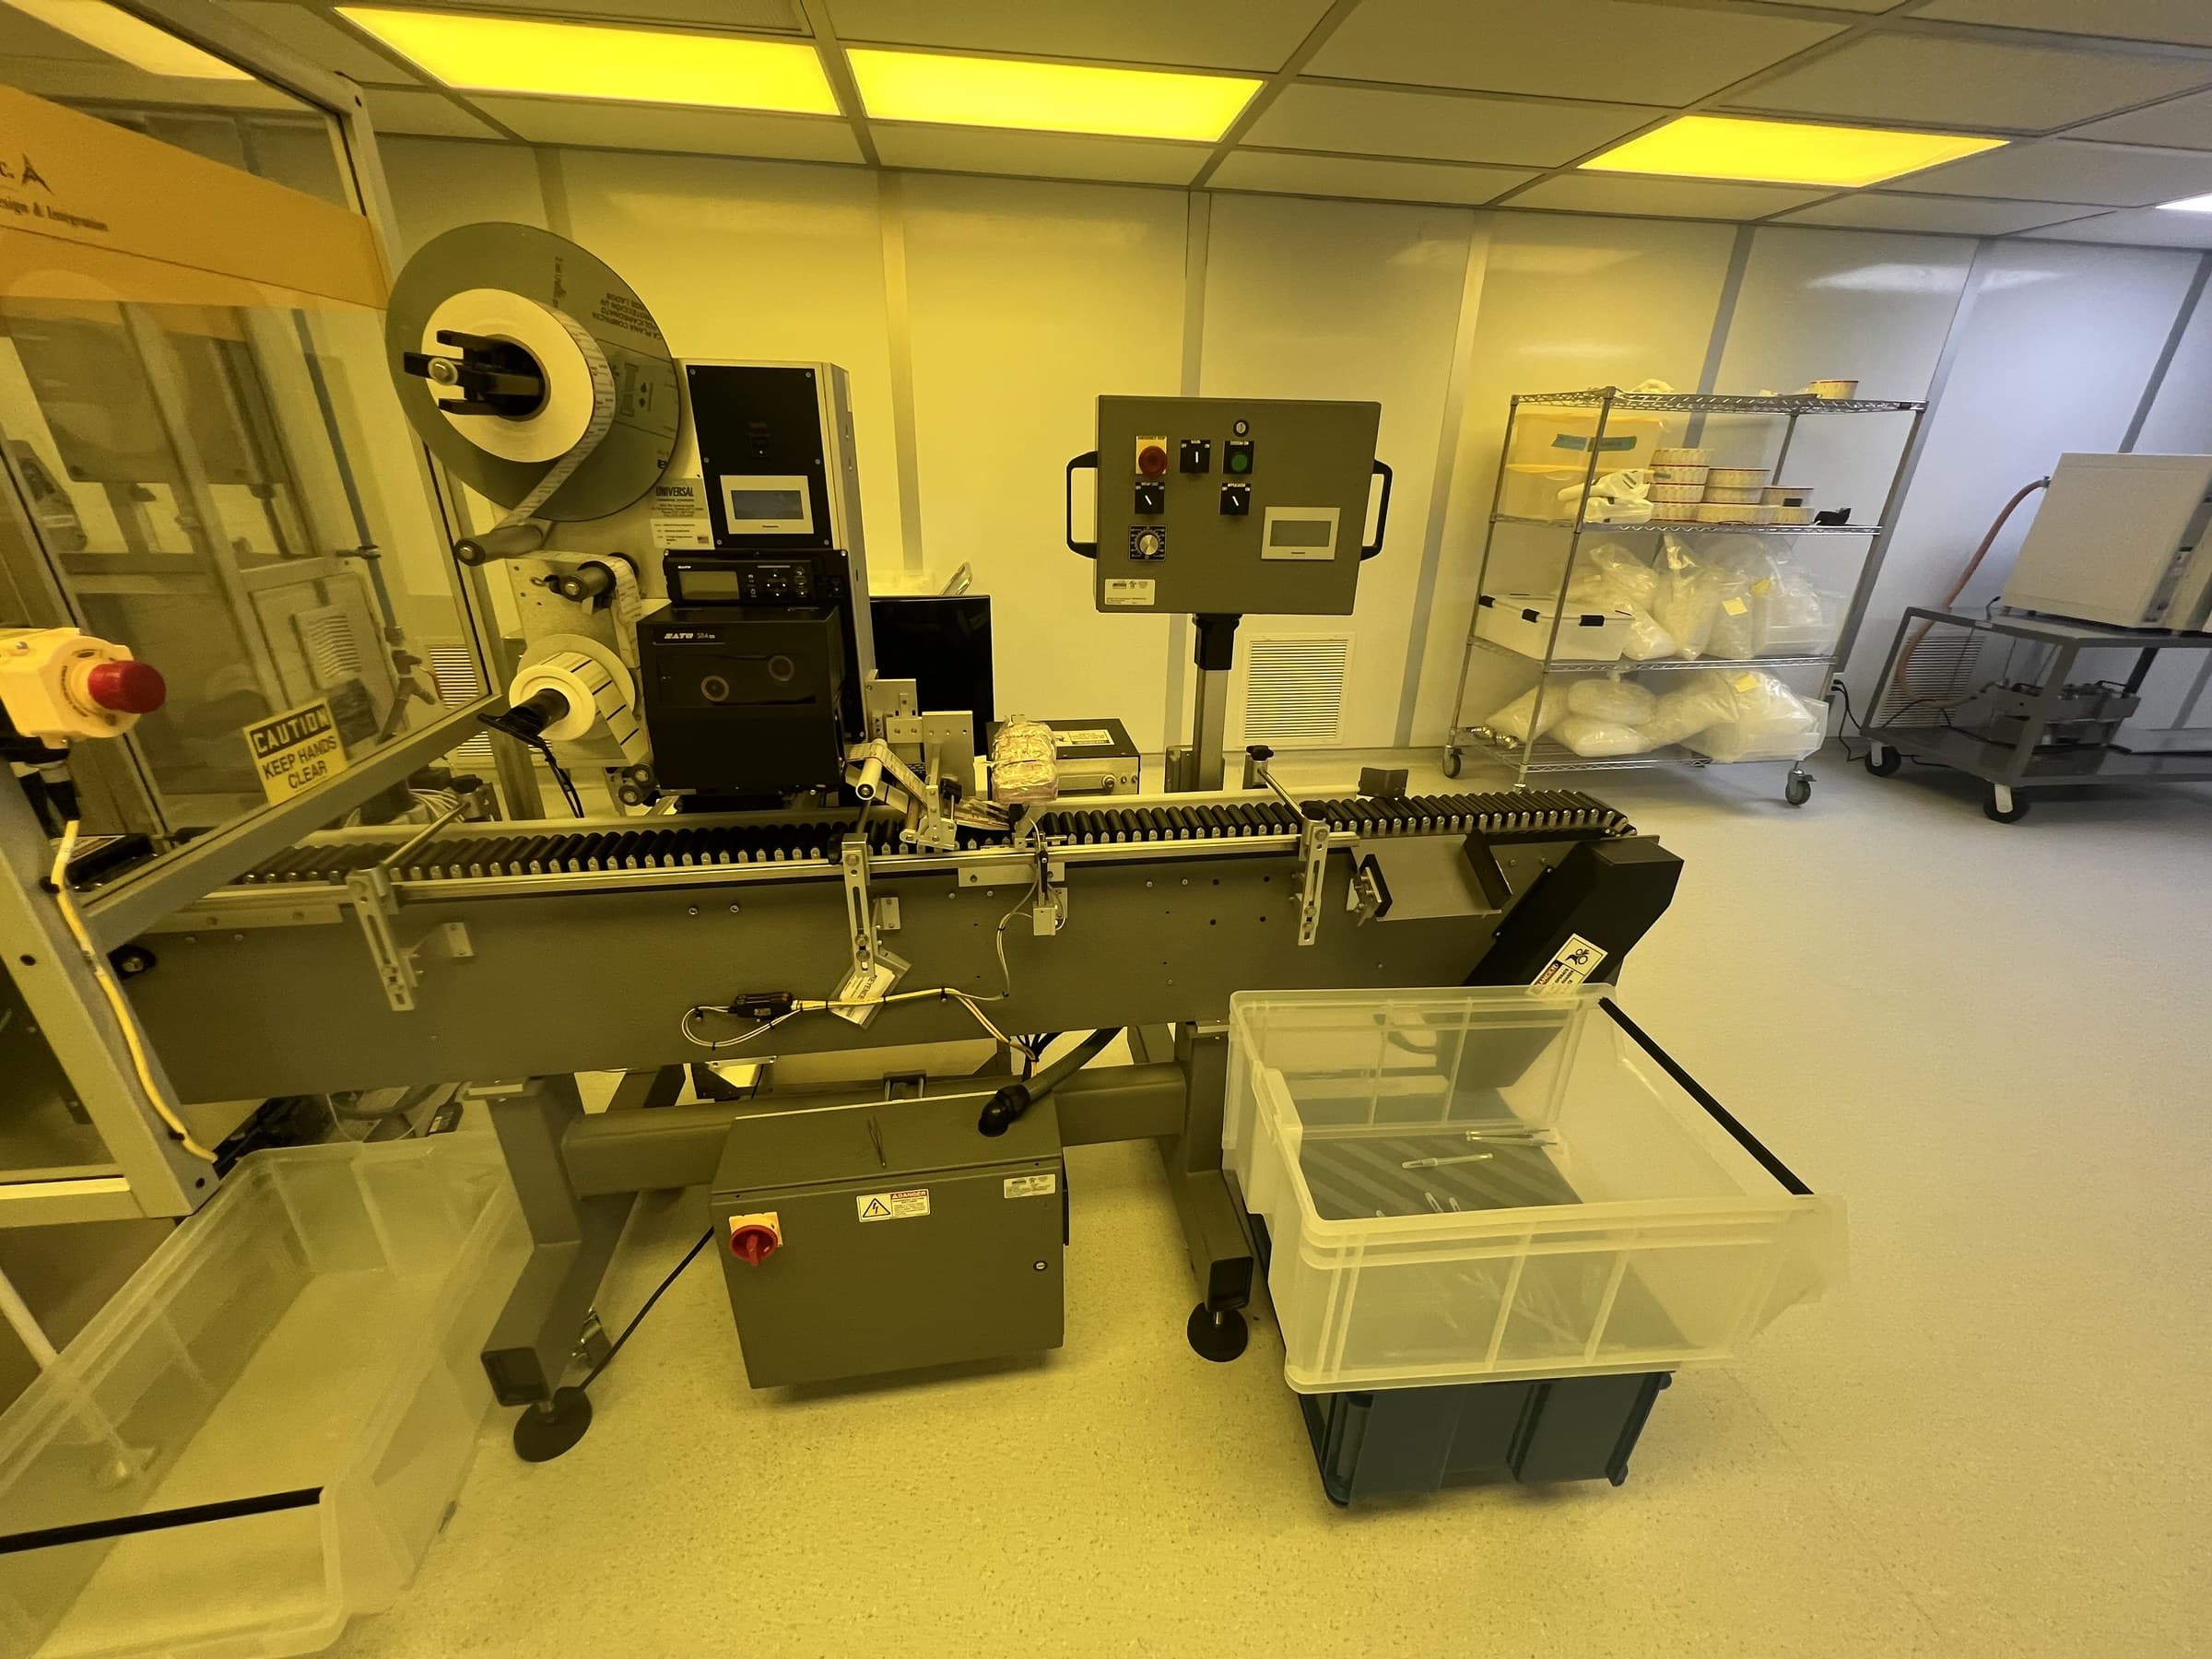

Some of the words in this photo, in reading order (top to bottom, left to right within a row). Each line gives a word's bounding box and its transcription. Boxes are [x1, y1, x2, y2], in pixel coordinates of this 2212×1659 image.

[656, 487, 694, 497] UNIVERSAL
[253, 707, 331, 754] CAUTION
[263, 753, 296, 781] KEEP
[297, 735, 337, 764] HANDS
[288, 759, 328, 789] CLEAR
[898, 1191, 926, 1199] DANGER
